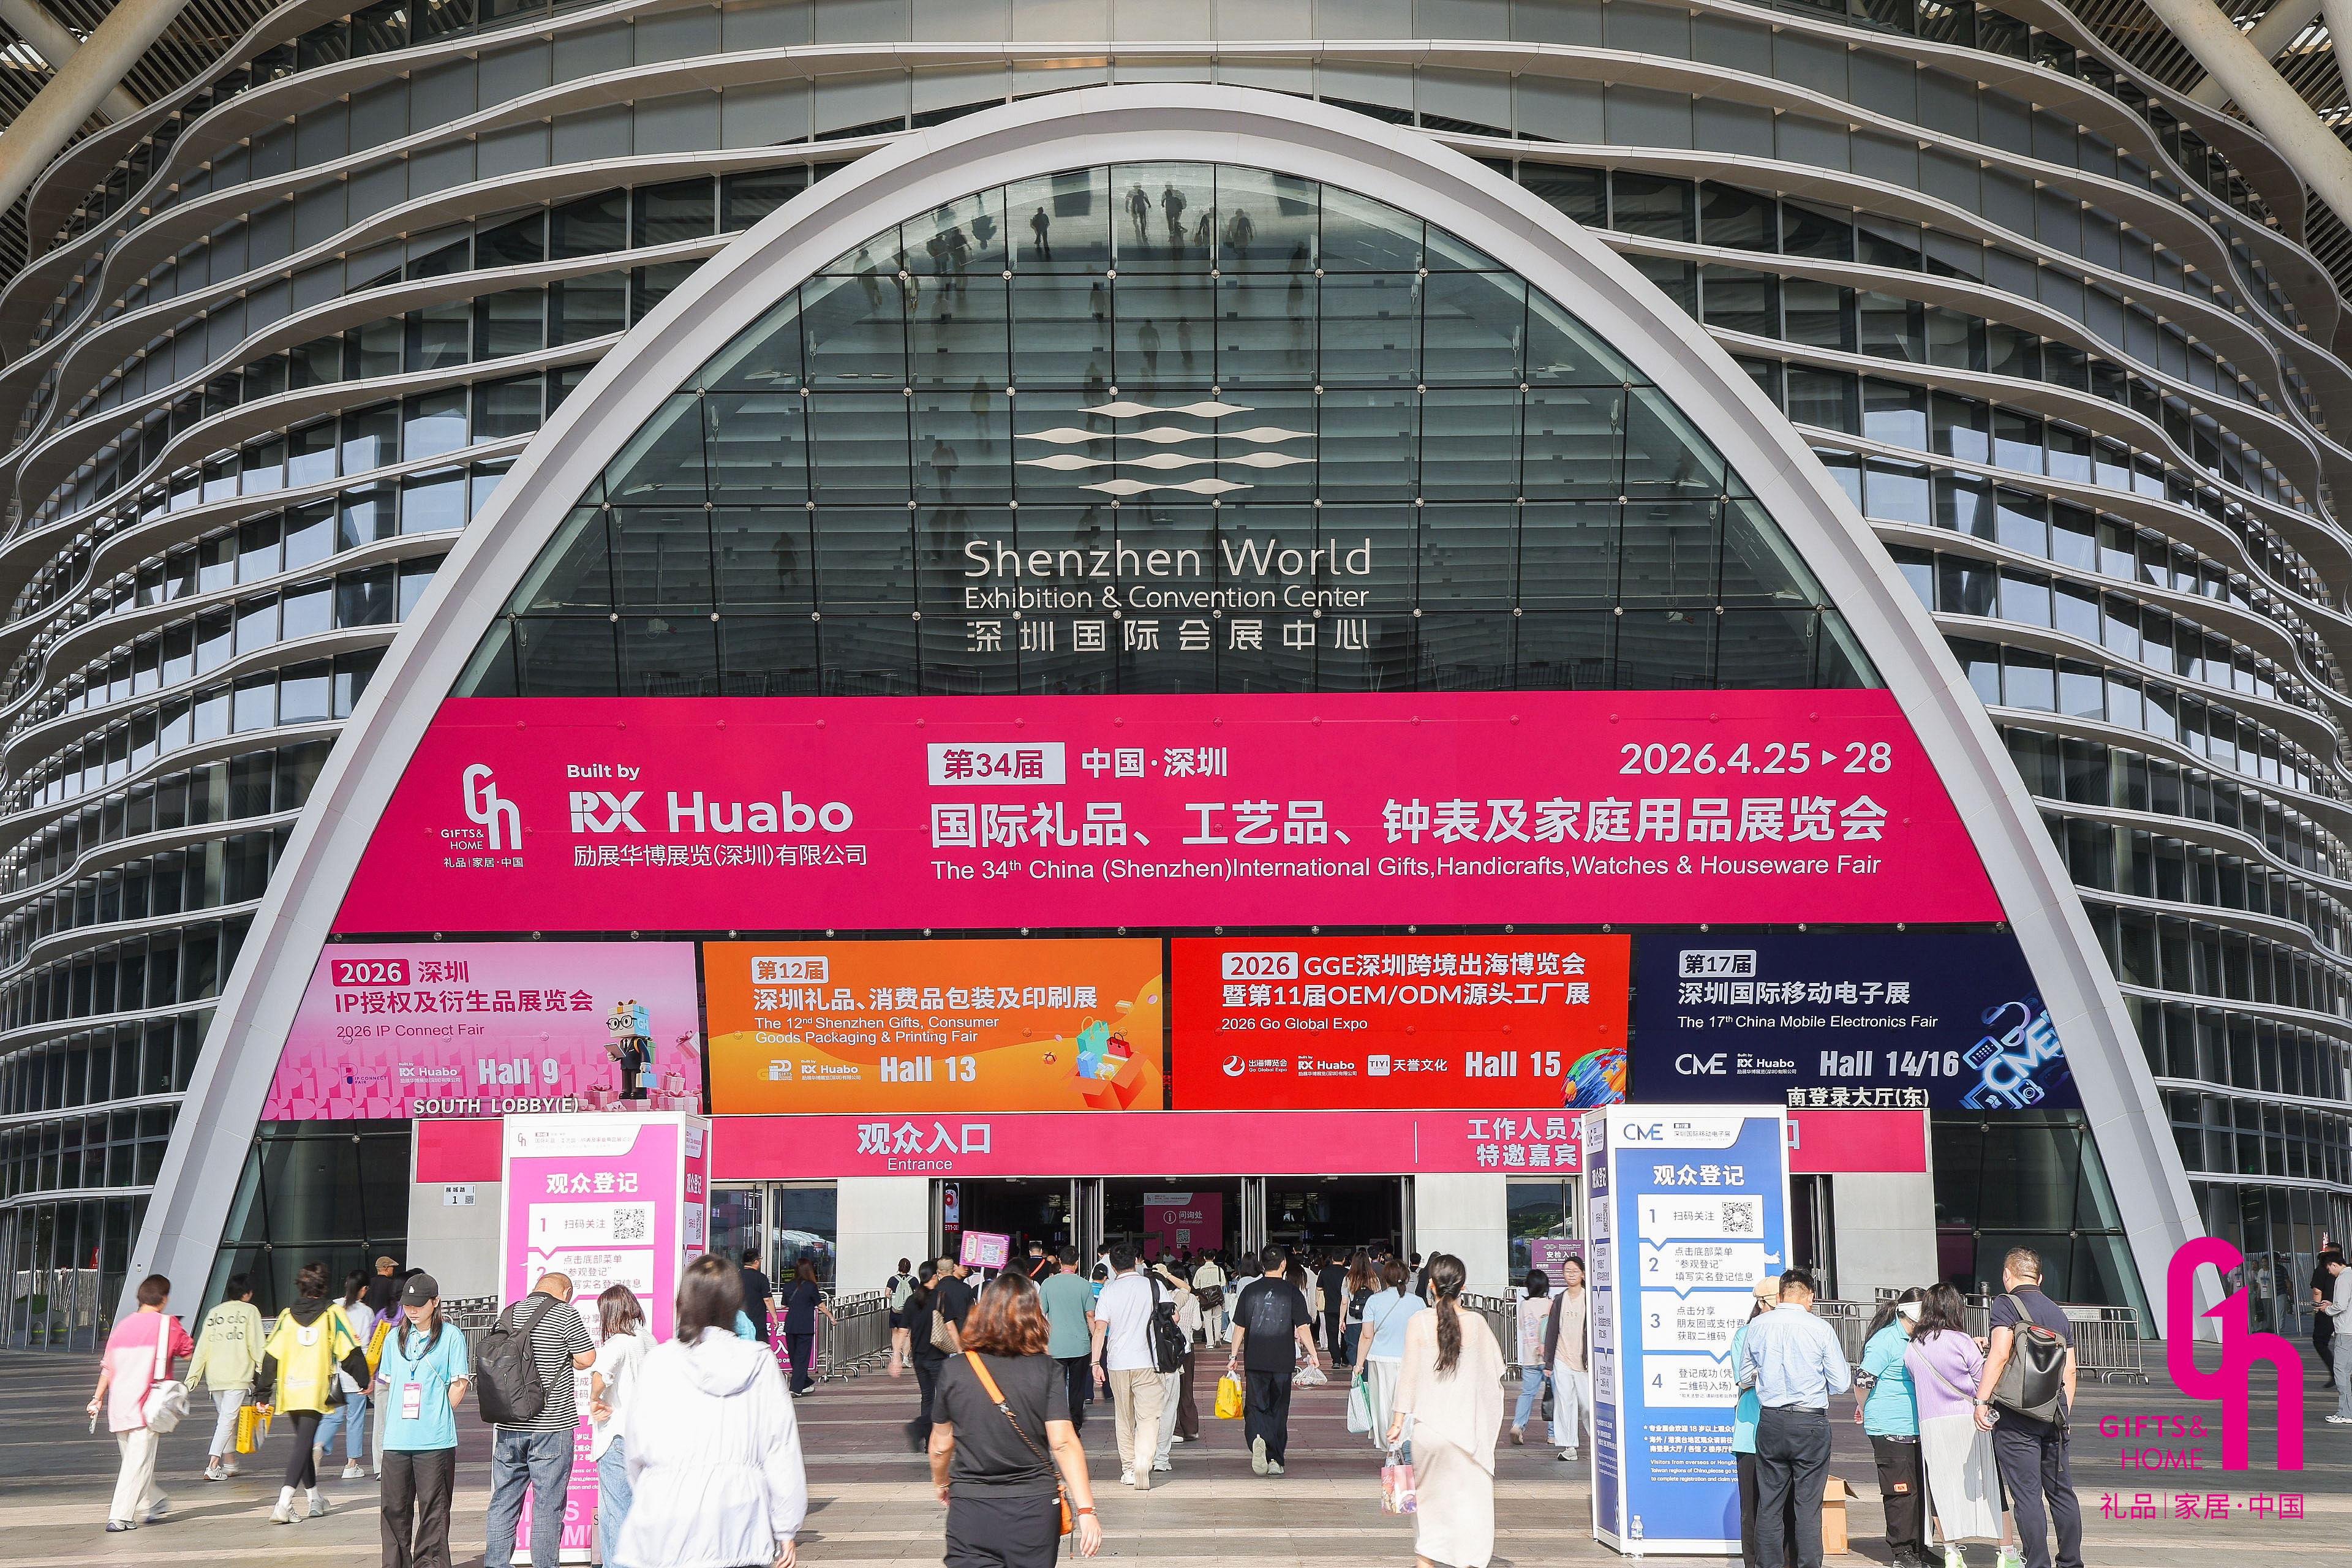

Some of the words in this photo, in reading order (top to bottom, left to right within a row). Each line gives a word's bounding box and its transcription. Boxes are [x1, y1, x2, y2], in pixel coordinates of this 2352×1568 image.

[964, 539, 1200, 577] Shenzhen
[1221, 538, 1371, 576] World
[965, 586, 1092, 609] Exhibition
[1102, 586, 1122, 608] &
[1128, 586, 1275, 608] Convention
[1284, 584, 1370, 608] Center
[966, 619, 1370, 652] 深圳国际会展中心
[942, 748, 1044, 780] 第34届
[1619, 742, 1811, 775] 2026.4.25
[1844, 742, 1892, 774] 28
[567, 764, 612, 779] Built
[617, 764, 640, 782] by
[570, 791, 647, 833] RX
[666, 791, 854, 834] Huabo
[450, 840, 483, 850] HOME
[573, 843, 867, 867] 励展华博展览(深圳)有限公司
[930, 860, 975, 880] The
[982, 859, 1022, 880] 34th
[1029, 859, 1095, 880] China
[1677, 856, 1693, 875] &
[1701, 856, 1829, 875] Houseware
[1838, 855, 1882, 875] Fair
[340, 963, 403, 983] 2026
[418, 960, 470, 983] 深圳
[757, 960, 824, 981] 第12届
[1231, 957, 1289, 975] 2026
[1303, 952, 1586, 977] GGE深圳跨境出海博览会
[1684, 954, 1752, 974] 第17届
[335, 989, 594, 1014] IP授权及衍生品展览会
[753, 986, 1098, 1012] 深圳礼品、消费品包装及印刷展
[1222, 982, 1590, 1008] 暨第11届OEM/ODM源头工厂展
[1678, 981, 1910, 1005] 深圳国际移动电子展
[336, 1025, 371, 1038] 2026
[376, 1025, 390, 1037] IP
[395, 1024, 453, 1036] Connect
[458, 1023, 485, 1036] Fair
[755, 1017, 783, 1029] The
[786, 1017, 813, 1029] 12nd
[816, 1017, 884, 1029] Shenzhen
[888, 1016, 924, 1030] Gifts,
[928, 1016, 1000, 1028] Consumer
[1221, 1018, 1256, 1030] 2026
[1260, 1017, 1280, 1030] Go
[1284, 1017, 1329, 1030] Global
[1333, 1017, 1368, 1032] Expo
[1678, 1016, 1704, 1028] The
[1709, 1016, 1733, 1027] 17th
[1736, 1016, 1776, 1027] China
[1781, 1016, 1825, 1027] Mobile
[1831, 1015, 1906, 1027] Electronics
[1911, 1015, 1938, 1027] Fair
[755, 1031, 801, 1044] Goods
[805, 1030, 877, 1047] Packaging
[881, 1031, 891, 1043] &
[895, 1030, 948, 1046] Printing
[952, 1030, 978, 1042] Fair
[1465, 1051, 1516, 1077] Hall
[1531, 1050, 1561, 1077] 15
[1757, 1059, 1795, 1068] Huabo
[1820, 1050, 1872, 1077] Hall
[1887, 1050, 1959, 1077] 14/16
[1985, 1018, 2061, 1091] CME
[399, 1068, 415, 1077] RX
[420, 1068, 458, 1076] Huabo
[478, 1058, 531, 1085] Hall
[543, 1058, 559, 1084] 9
[801, 1065, 817, 1074] RX
[821, 1065, 858, 1073] Huabo
[880, 1057, 932, 1082] Hall
[945, 1056, 976, 1082] 13
[1298, 1061, 1314, 1070] RX
[1317, 1060, 1355, 1069] Huabo
[1393, 1058, 1448, 1071] 天誉文化
[1675, 1054, 1727, 1075] CME
[412, 1099, 481, 1115] SOUTH
[491, 1097, 579, 1114] LOBBY(E)
[1787, 1087, 1929, 1107] 南登录大厅(东)
[857, 1121, 991, 1155] 观众入口
[1624, 1123, 1663, 1140] CME
[888, 1158, 953, 1170] Entrance
[1476, 1144, 1577, 1167] 特邀嘉宾
[546, 1172, 638, 1194] 观众登记
[687, 1173, 702, 1194] 观众登记
[1592, 1167, 1607, 1188] 观众登记
[1653, 1164, 1744, 1186] 观众登记
[453, 1196, 458, 1204] 1
[540, 1218, 546, 1232] 1
[564, 1219, 606, 1229] 扫码关注
[1649, 1209, 1656, 1223] 1
[1673, 1211, 1714, 1221] 扫码关注
[564, 1254, 622, 1265] 点击底部菜单
[1675, 1247, 1733, 1256] 点击底部菜单
[1649, 1257, 1659, 1272] 2
[572, 1279, 641, 1290] 写实名登记信息
[1675, 1272, 1754, 1281] 填写实名登记信息
[1677, 1306, 1715, 1316] 点击分享
[1650, 1313, 1660, 1328] 3
[1677, 1332, 1726, 1341] 获取二维码
[1652, 1374, 1663, 1388] 4
[1679, 1381, 1732, 1392] 二维码入场)
